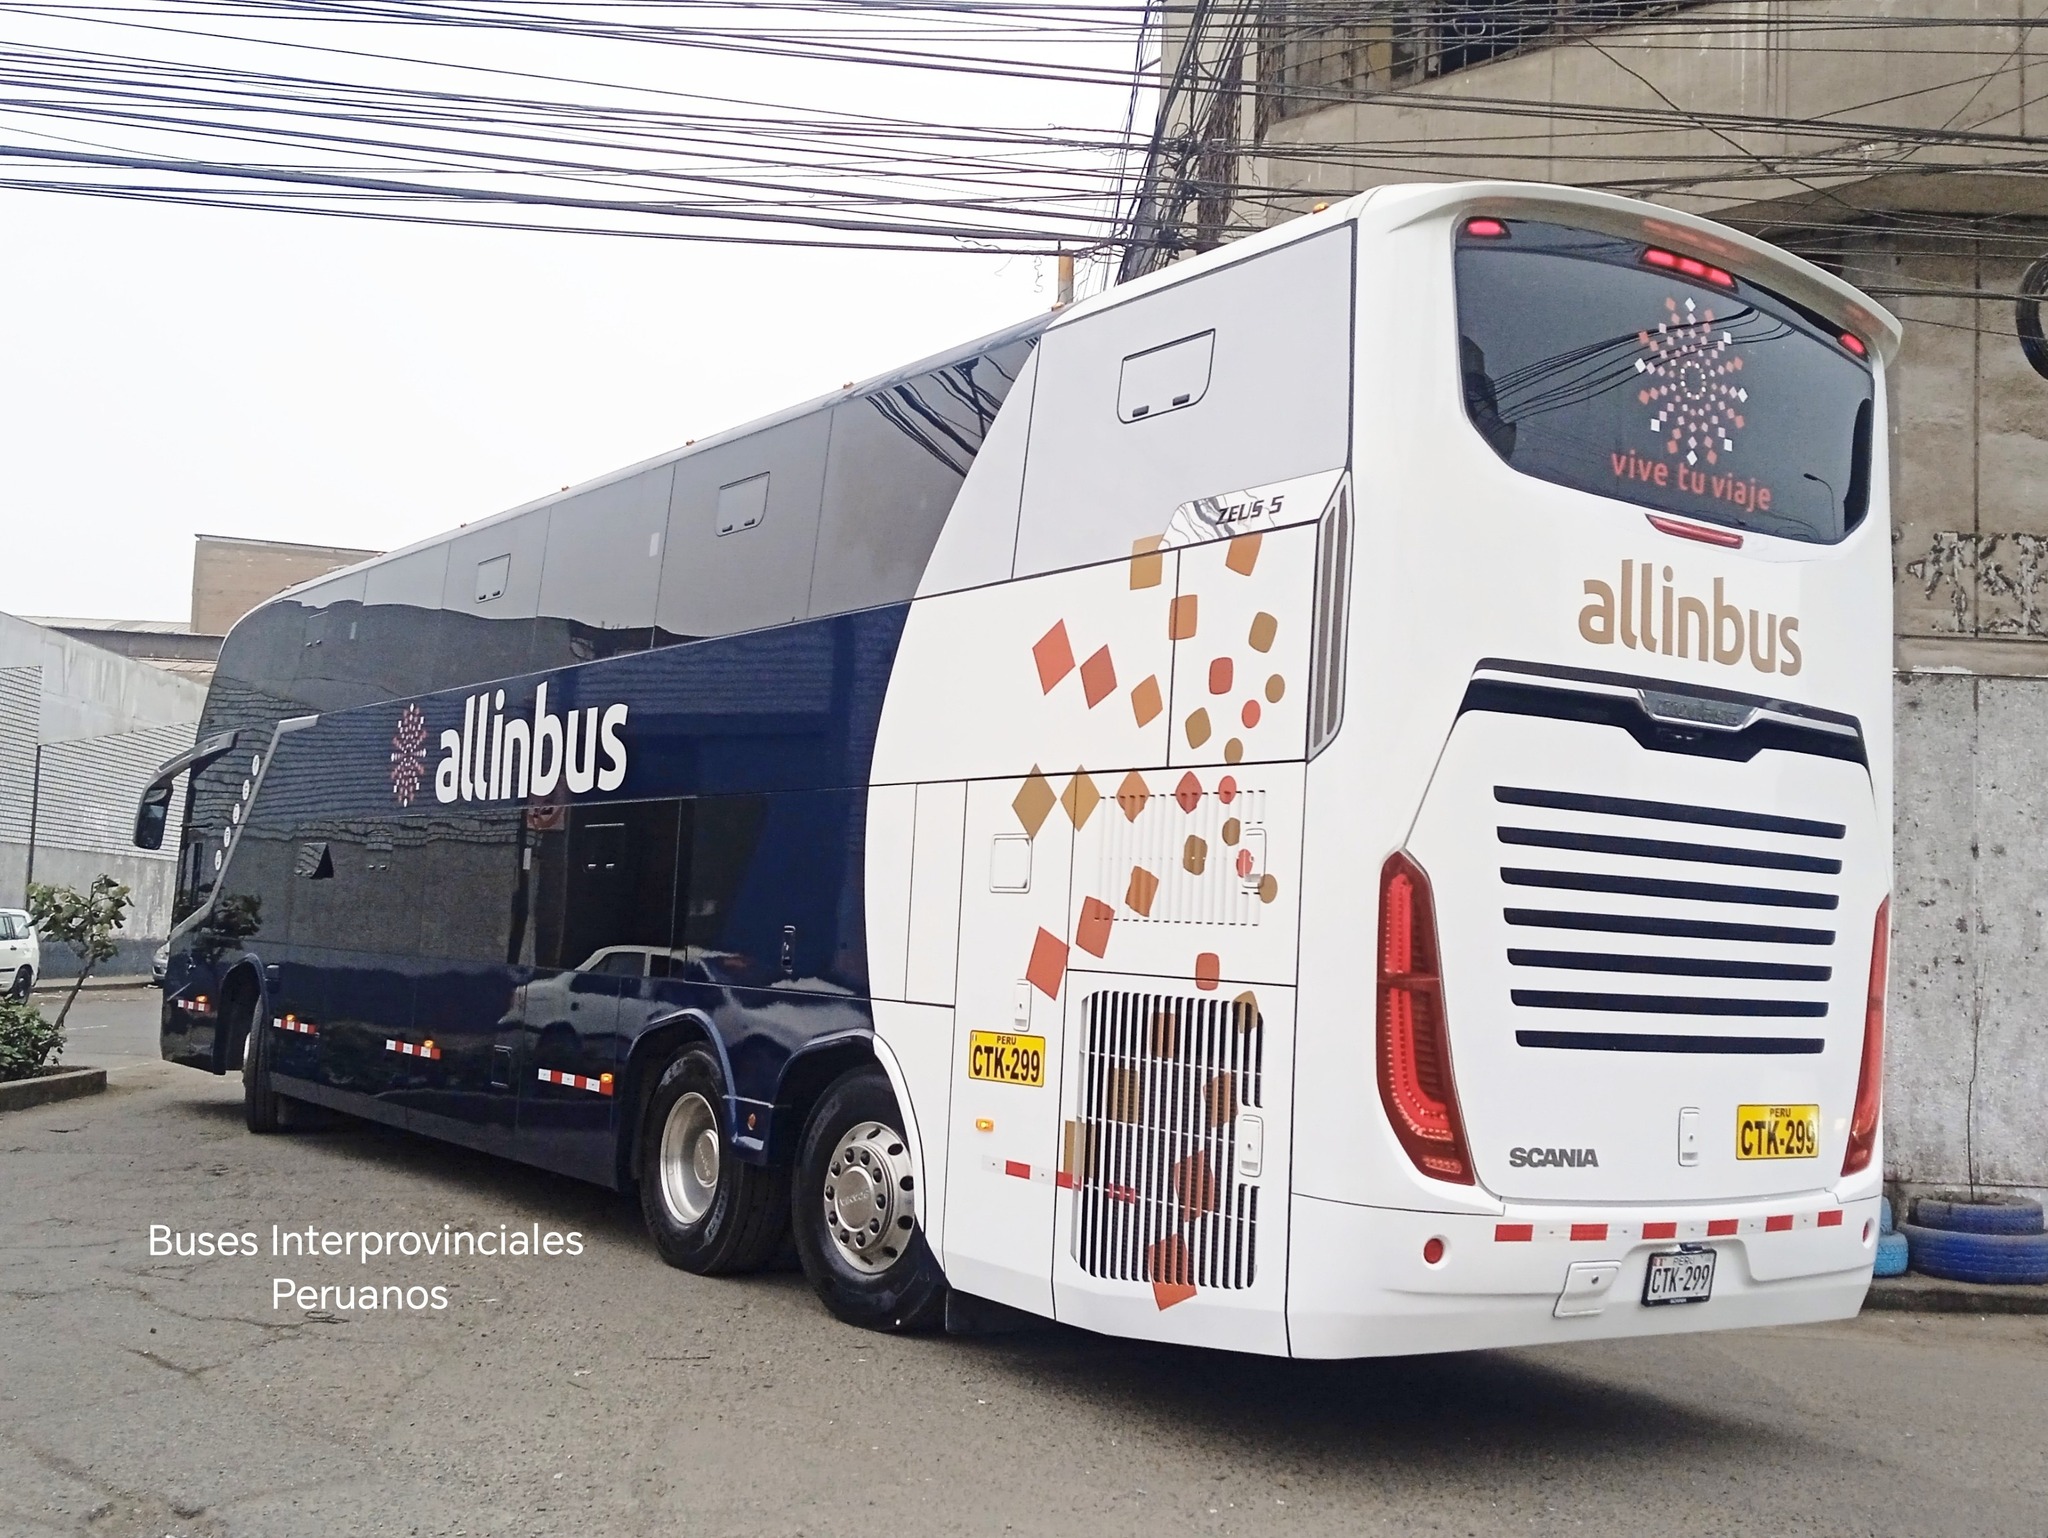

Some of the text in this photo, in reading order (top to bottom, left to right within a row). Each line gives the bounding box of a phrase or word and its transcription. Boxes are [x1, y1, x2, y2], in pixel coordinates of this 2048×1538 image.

[1611, 449, 1772, 513] vive tu viaje
[1215, 500, 1264, 525] ZEUS
[1578, 558, 1802, 676] allinbus
[435, 680, 629, 803] allinbus
[996, 1035, 1017, 1046] PERU
[972, 1044, 1041, 1083] CTK-299
[1769, 1107, 1792, 1118] PERU
[1741, 1120, 1815, 1156] CTK-299
[1509, 1147, 1599, 1168] SCANIA
[1651, 1264, 1711, 1293] CTK-299
